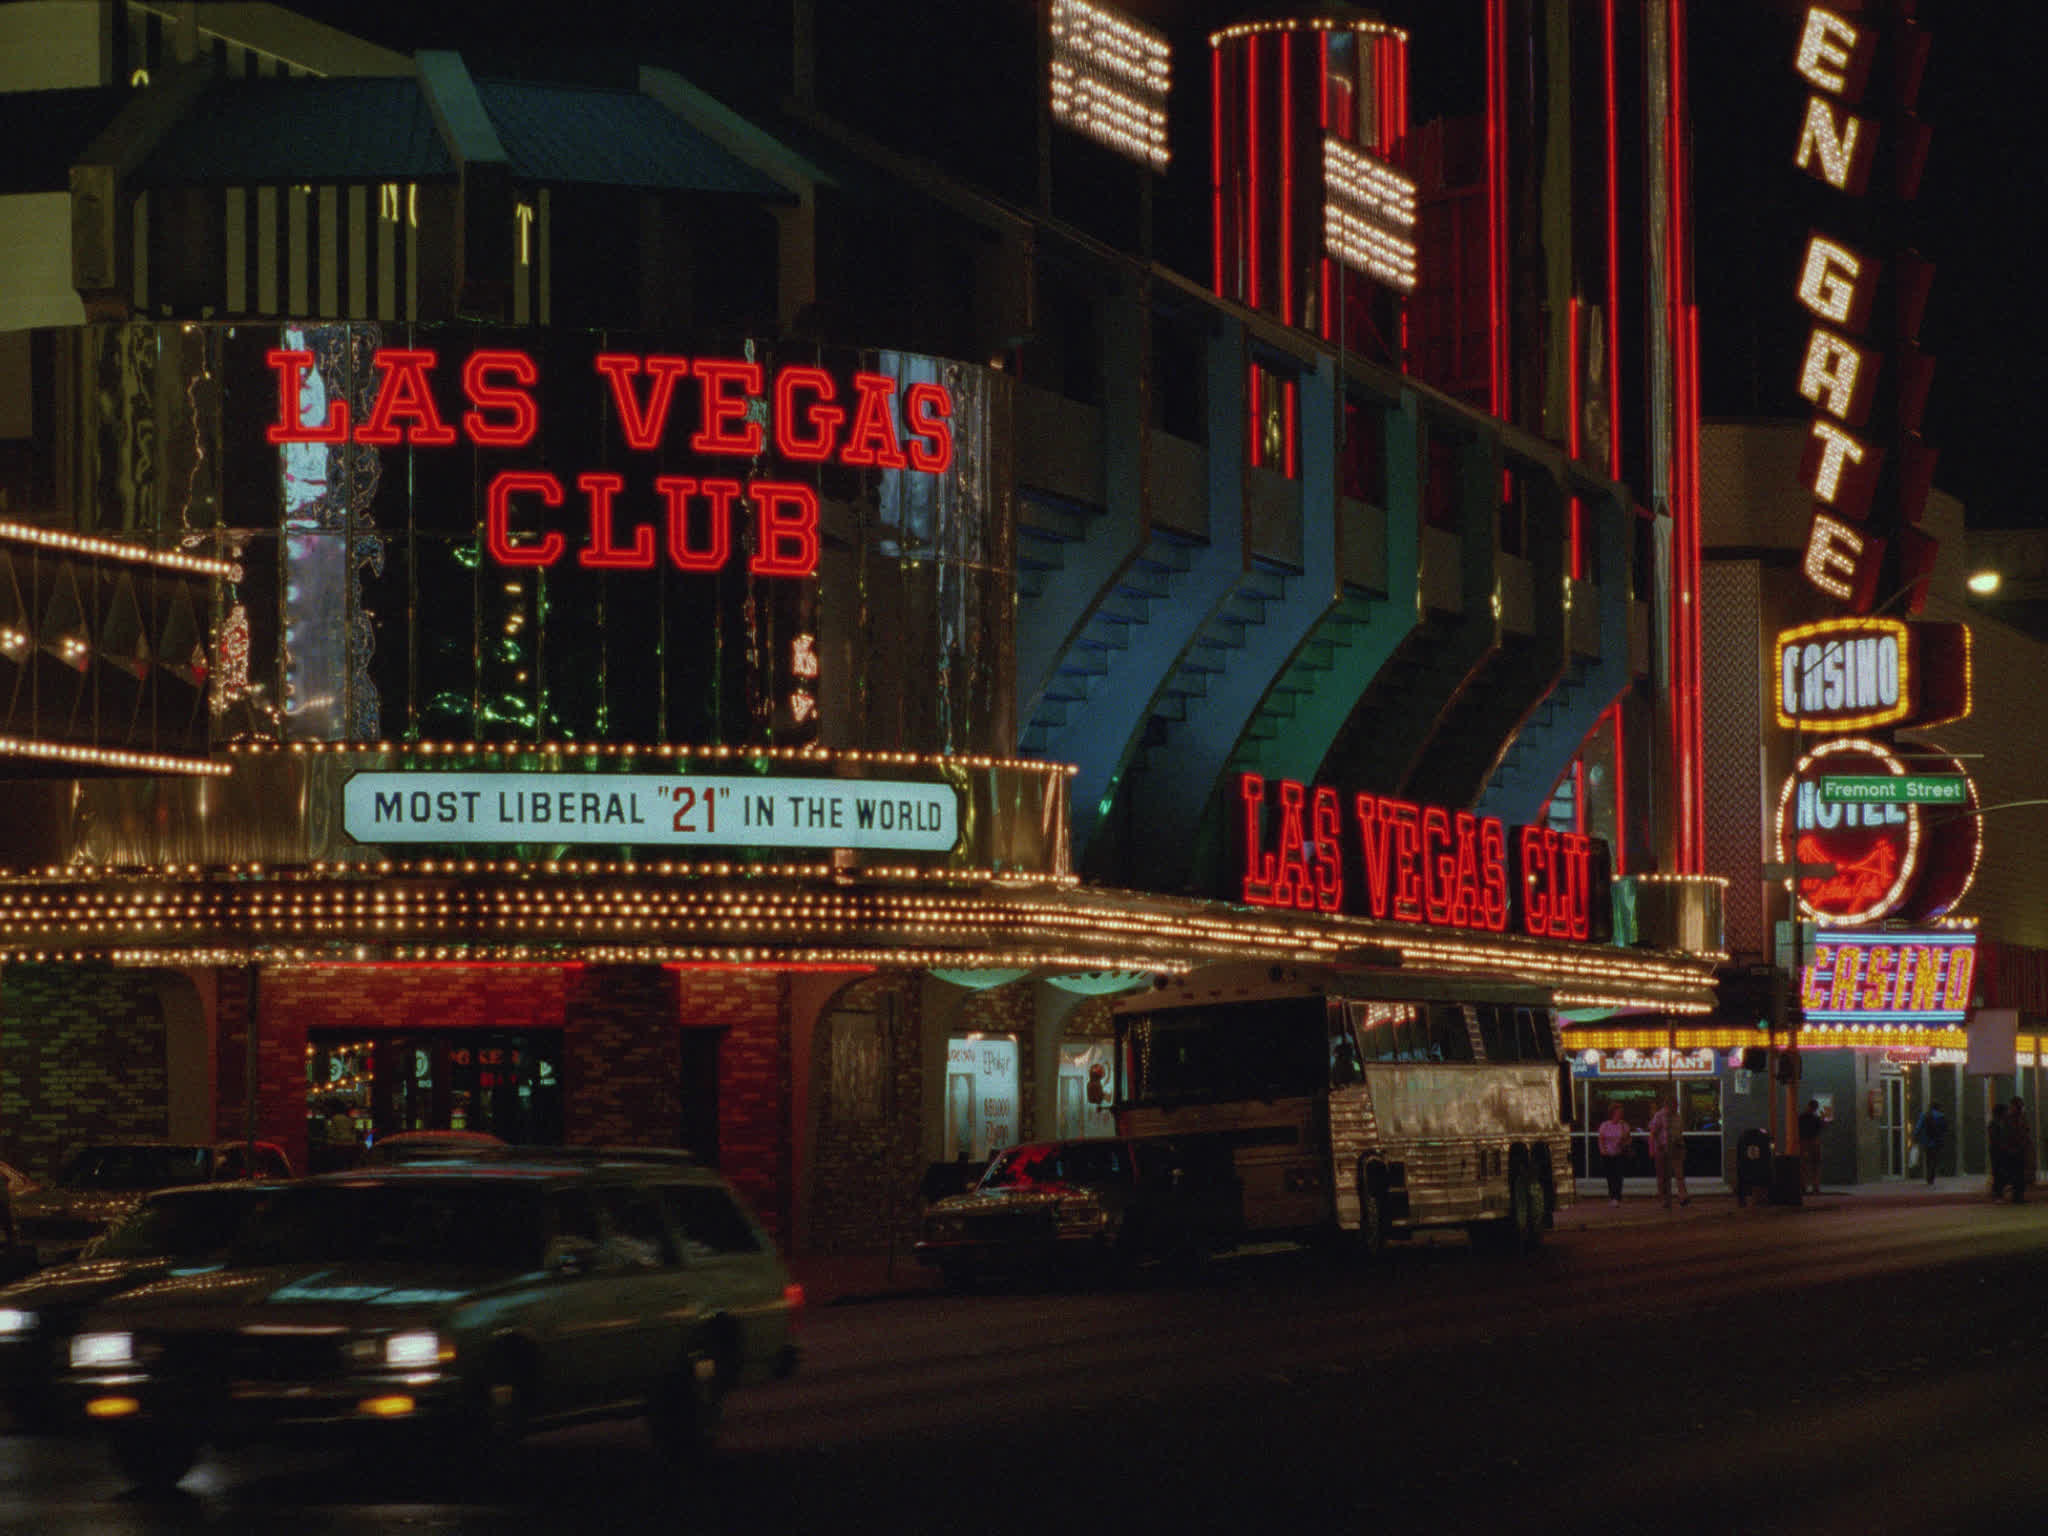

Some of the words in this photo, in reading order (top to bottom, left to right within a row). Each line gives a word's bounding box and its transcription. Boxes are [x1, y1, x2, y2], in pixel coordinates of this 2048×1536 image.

[267, 349, 538, 447] LAS
[597, 354, 953, 474] VEGAS
[1799, 237, 1865, 599] GATE
[488, 472, 820, 577] CLUB
[1783, 636, 1900, 715] CASINO
[374, 791, 482, 824] MOST
[498, 792, 645, 826] LIBERAL
[657, 785, 731, 834] "21"
[744, 796, 776, 828] IN
[789, 796, 844, 829] THE
[856, 799, 943, 833] WORLD
[1824, 782, 1897, 798] Fremont
[1906, 782, 1962, 799] Street
[1242, 773, 1343, 912] LAS
[1357, 793, 1507, 931] VEGAS
[1801, 943, 1975, 1012] CASINO
